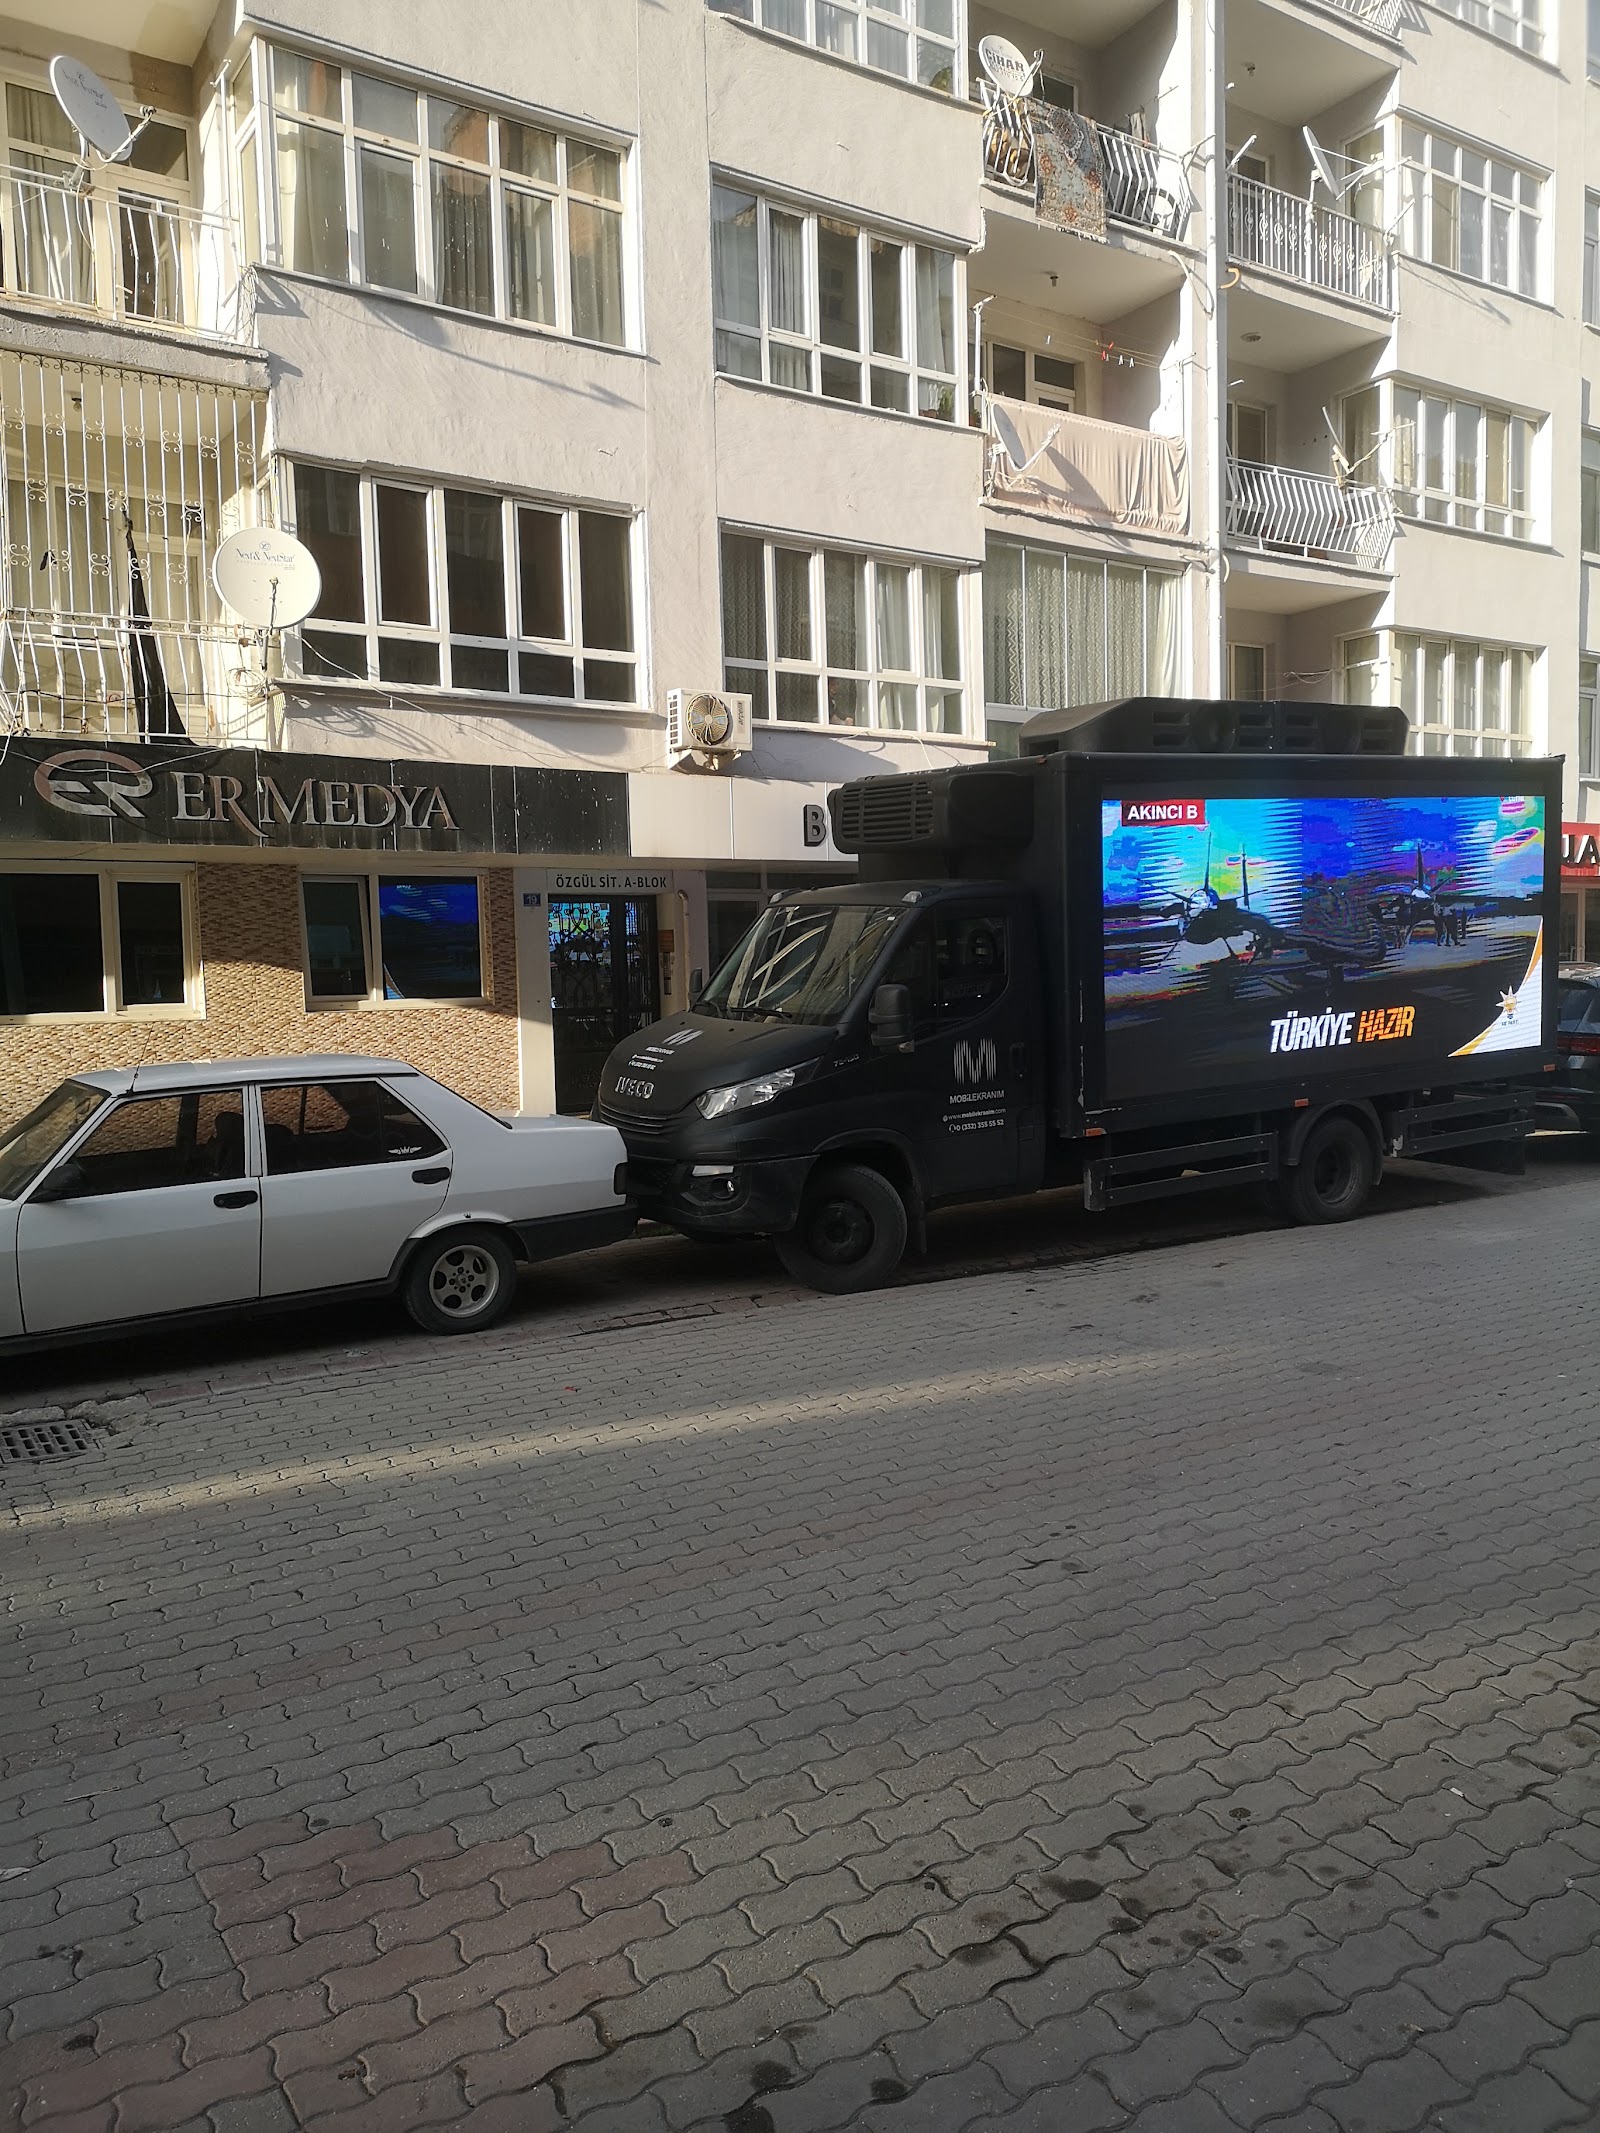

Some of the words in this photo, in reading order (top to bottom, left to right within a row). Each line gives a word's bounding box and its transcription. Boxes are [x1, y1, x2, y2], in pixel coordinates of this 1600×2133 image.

[258, 776, 461, 830] MEDYA
[1127, 804, 1183, 821] AKINCI
[1187, 804, 1198, 819] B
[556, 873, 596, 888] ÖZGÜL
[599, 874, 621, 888] SİT.
[624, 876, 667, 888] A-BLOK
[526, 895, 538, 905] 19
[1270, 1006, 1356, 1053] TÜRKİYE
[1357, 1005, 1416, 1043] HAZIR
[615, 1076, 654, 1099] IVECO
